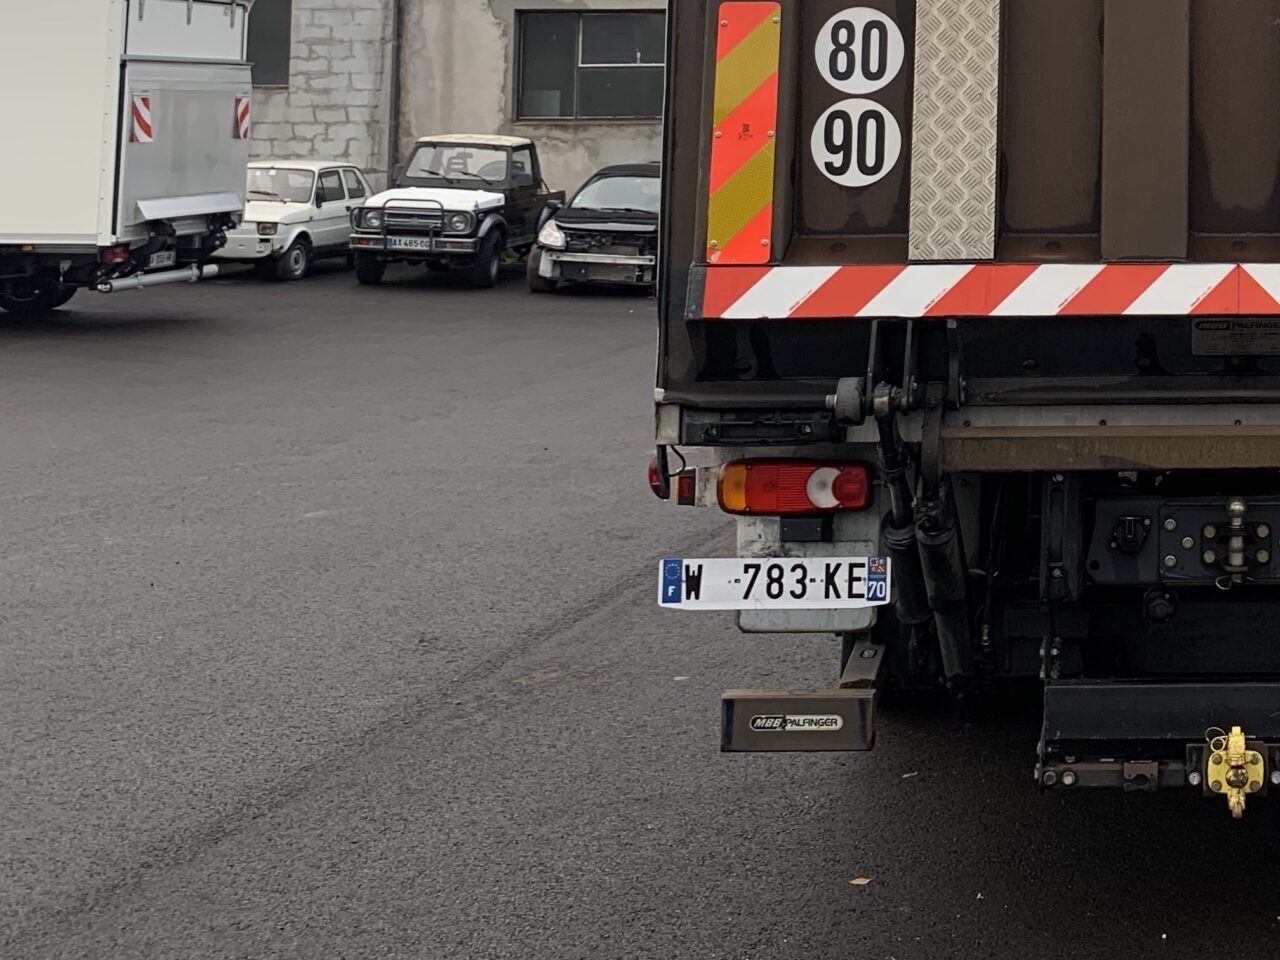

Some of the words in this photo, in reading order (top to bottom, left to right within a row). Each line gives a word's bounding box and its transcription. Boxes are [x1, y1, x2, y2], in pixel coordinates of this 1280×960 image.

[828, 19, 888, 81] 80
[824, 109, 886, 176] 90
[667, 586, 675, 597] F
[684, 564, 703, 601] W
[868, 580, 886, 598] 70
[753, 718, 782, 728] MBB
[785, 718, 838, 728] PALFINGER
